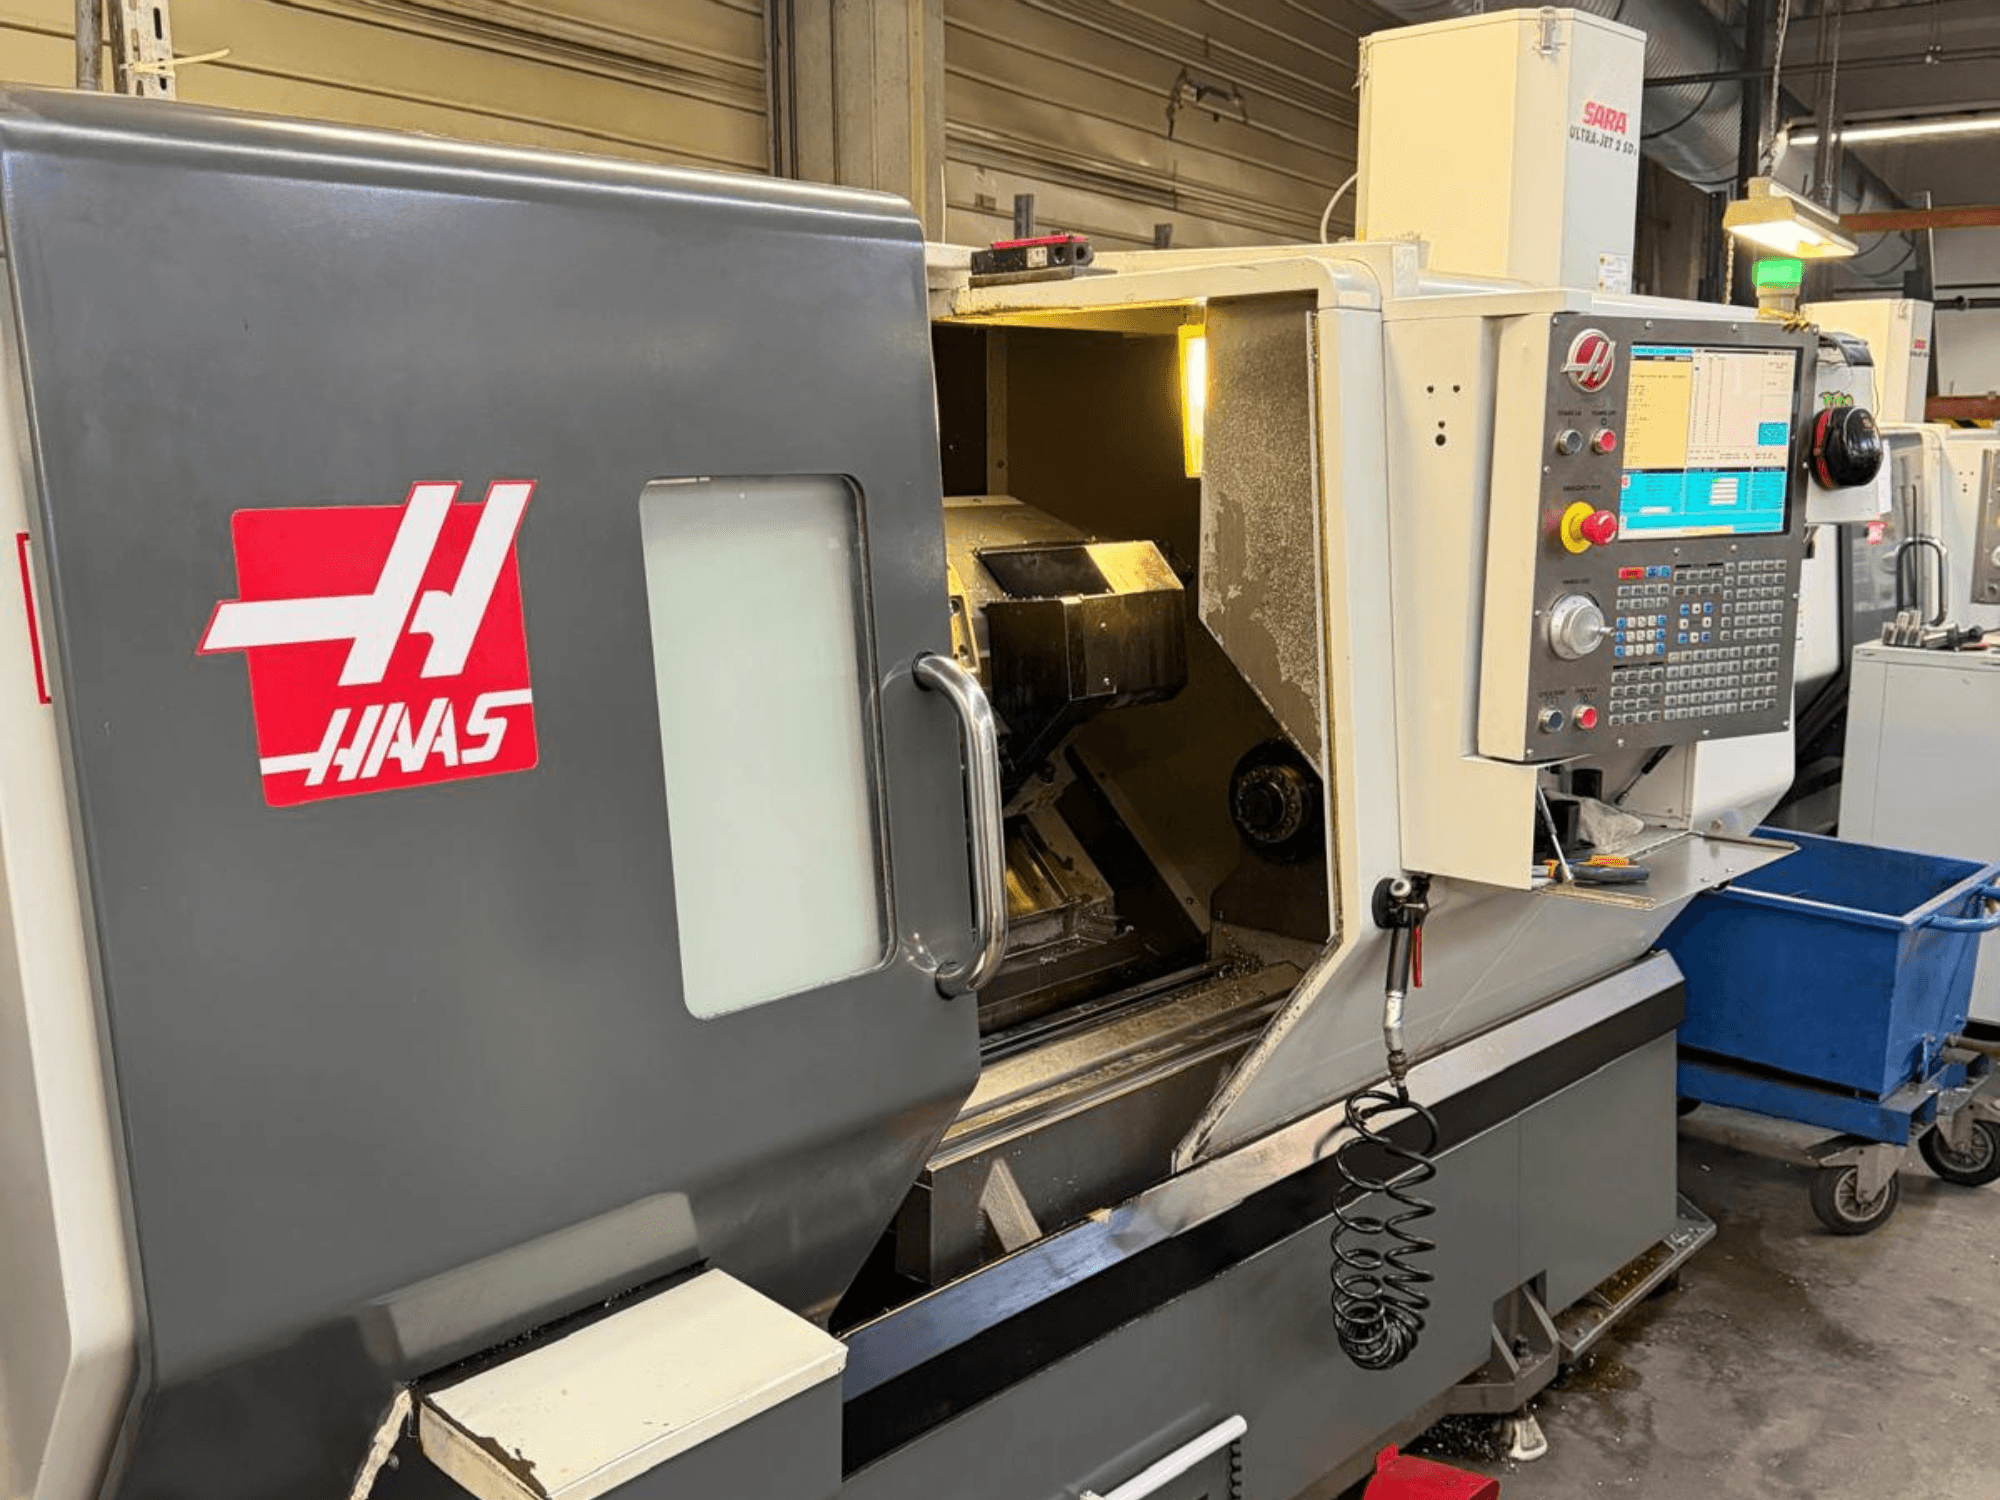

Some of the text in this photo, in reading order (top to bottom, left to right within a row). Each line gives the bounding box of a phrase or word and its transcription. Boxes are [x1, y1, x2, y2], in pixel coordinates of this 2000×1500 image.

[1584, 102, 1627, 133] SARA
[1569, 126, 1613, 148] ULTRA-JET
[260, 687, 533, 787] HAAS
